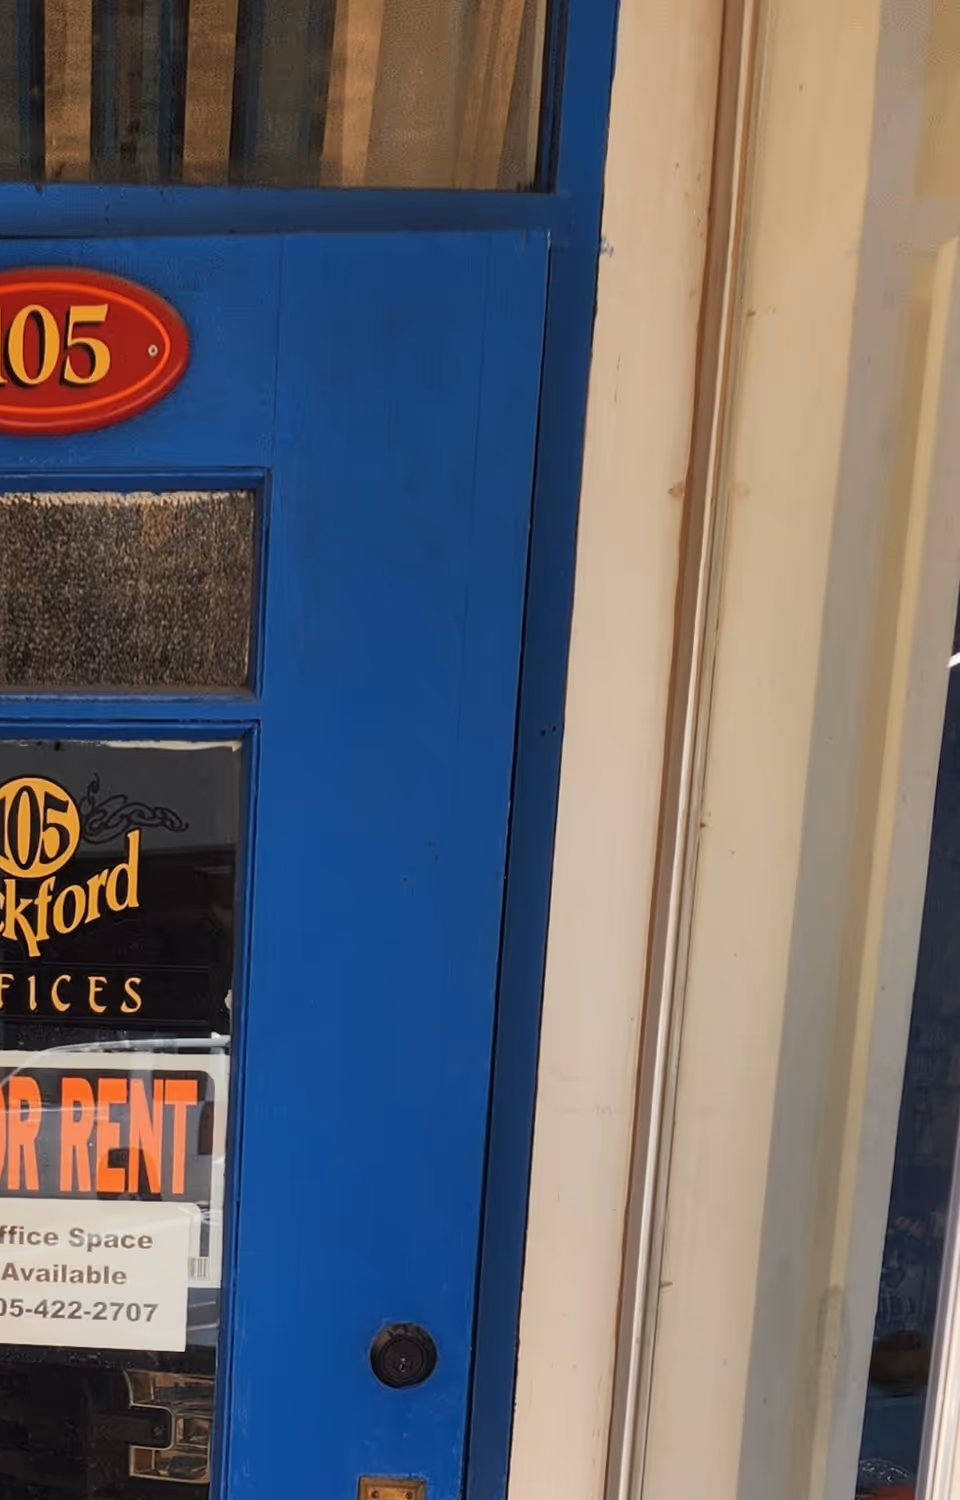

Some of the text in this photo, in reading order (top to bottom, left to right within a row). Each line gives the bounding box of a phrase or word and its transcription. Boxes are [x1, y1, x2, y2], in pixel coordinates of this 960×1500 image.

[58, 1077, 199, 1195] RENT
[68, 1228, 154, 1252] Space
[0, 1262, 128, 1286] Available
